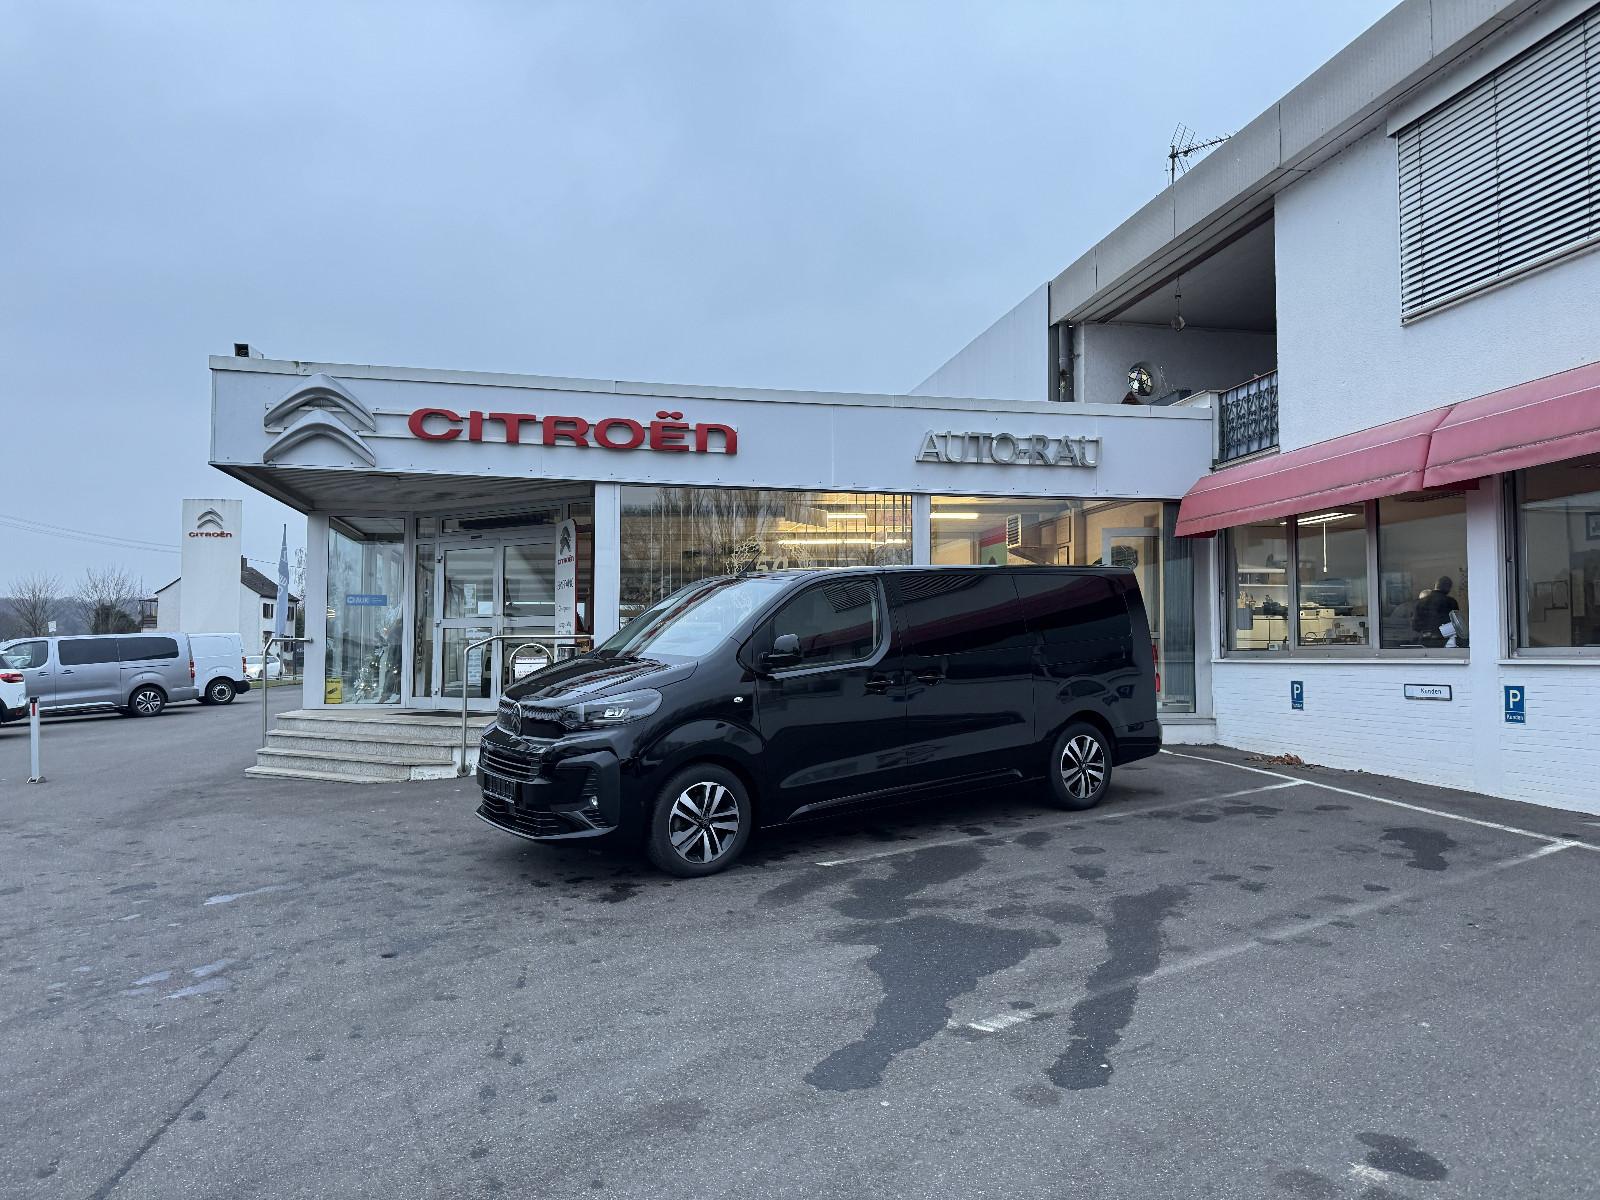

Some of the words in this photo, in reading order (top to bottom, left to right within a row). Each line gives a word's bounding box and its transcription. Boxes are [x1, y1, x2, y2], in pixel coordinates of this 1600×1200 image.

[408, 408, 737, 455] CITROËN
[915, 429, 1103, 468] AUTO-RAU
[188, 530, 232, 538] CITROËN
[1420, 687, 1442, 695] Kunden
[1509, 689, 1521, 709] P
